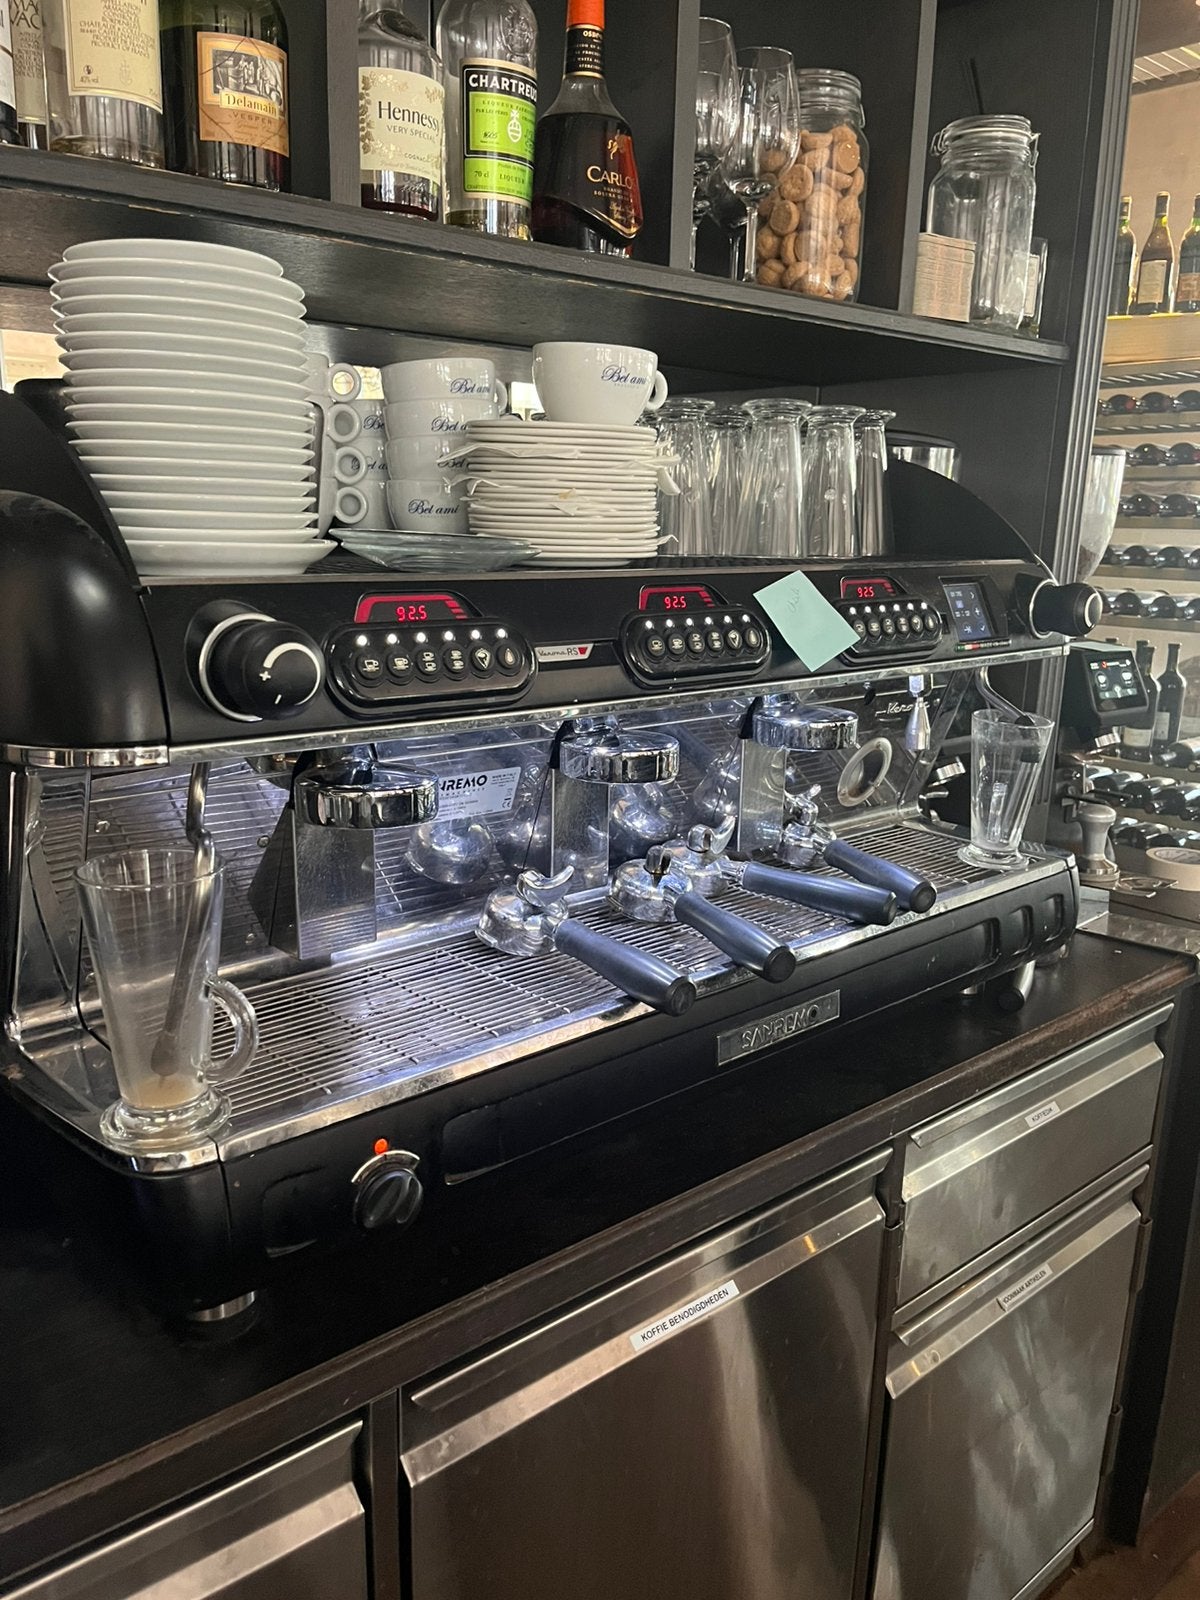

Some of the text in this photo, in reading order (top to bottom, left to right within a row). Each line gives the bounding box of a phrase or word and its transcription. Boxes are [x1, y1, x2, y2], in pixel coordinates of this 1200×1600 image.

[225, 94, 277, 117] Delamain
[232, 111, 272, 125] VESPER
[387, 124, 409, 134] VERY
[601, 364, 630, 383] Bel
[450, 378, 475, 394] Bel
[431, 416, 458, 431] Bel
[408, 499, 460, 515] Bel ami
[664, 595, 687, 609] 92.5
[396, 604, 428, 622] 92.5
[538, 647, 579, 657] Verona RS
[742, 1004, 819, 1049] SANREMO
[640, 1288, 729, 1342] KOFFIE BENODIGDHEDEN
